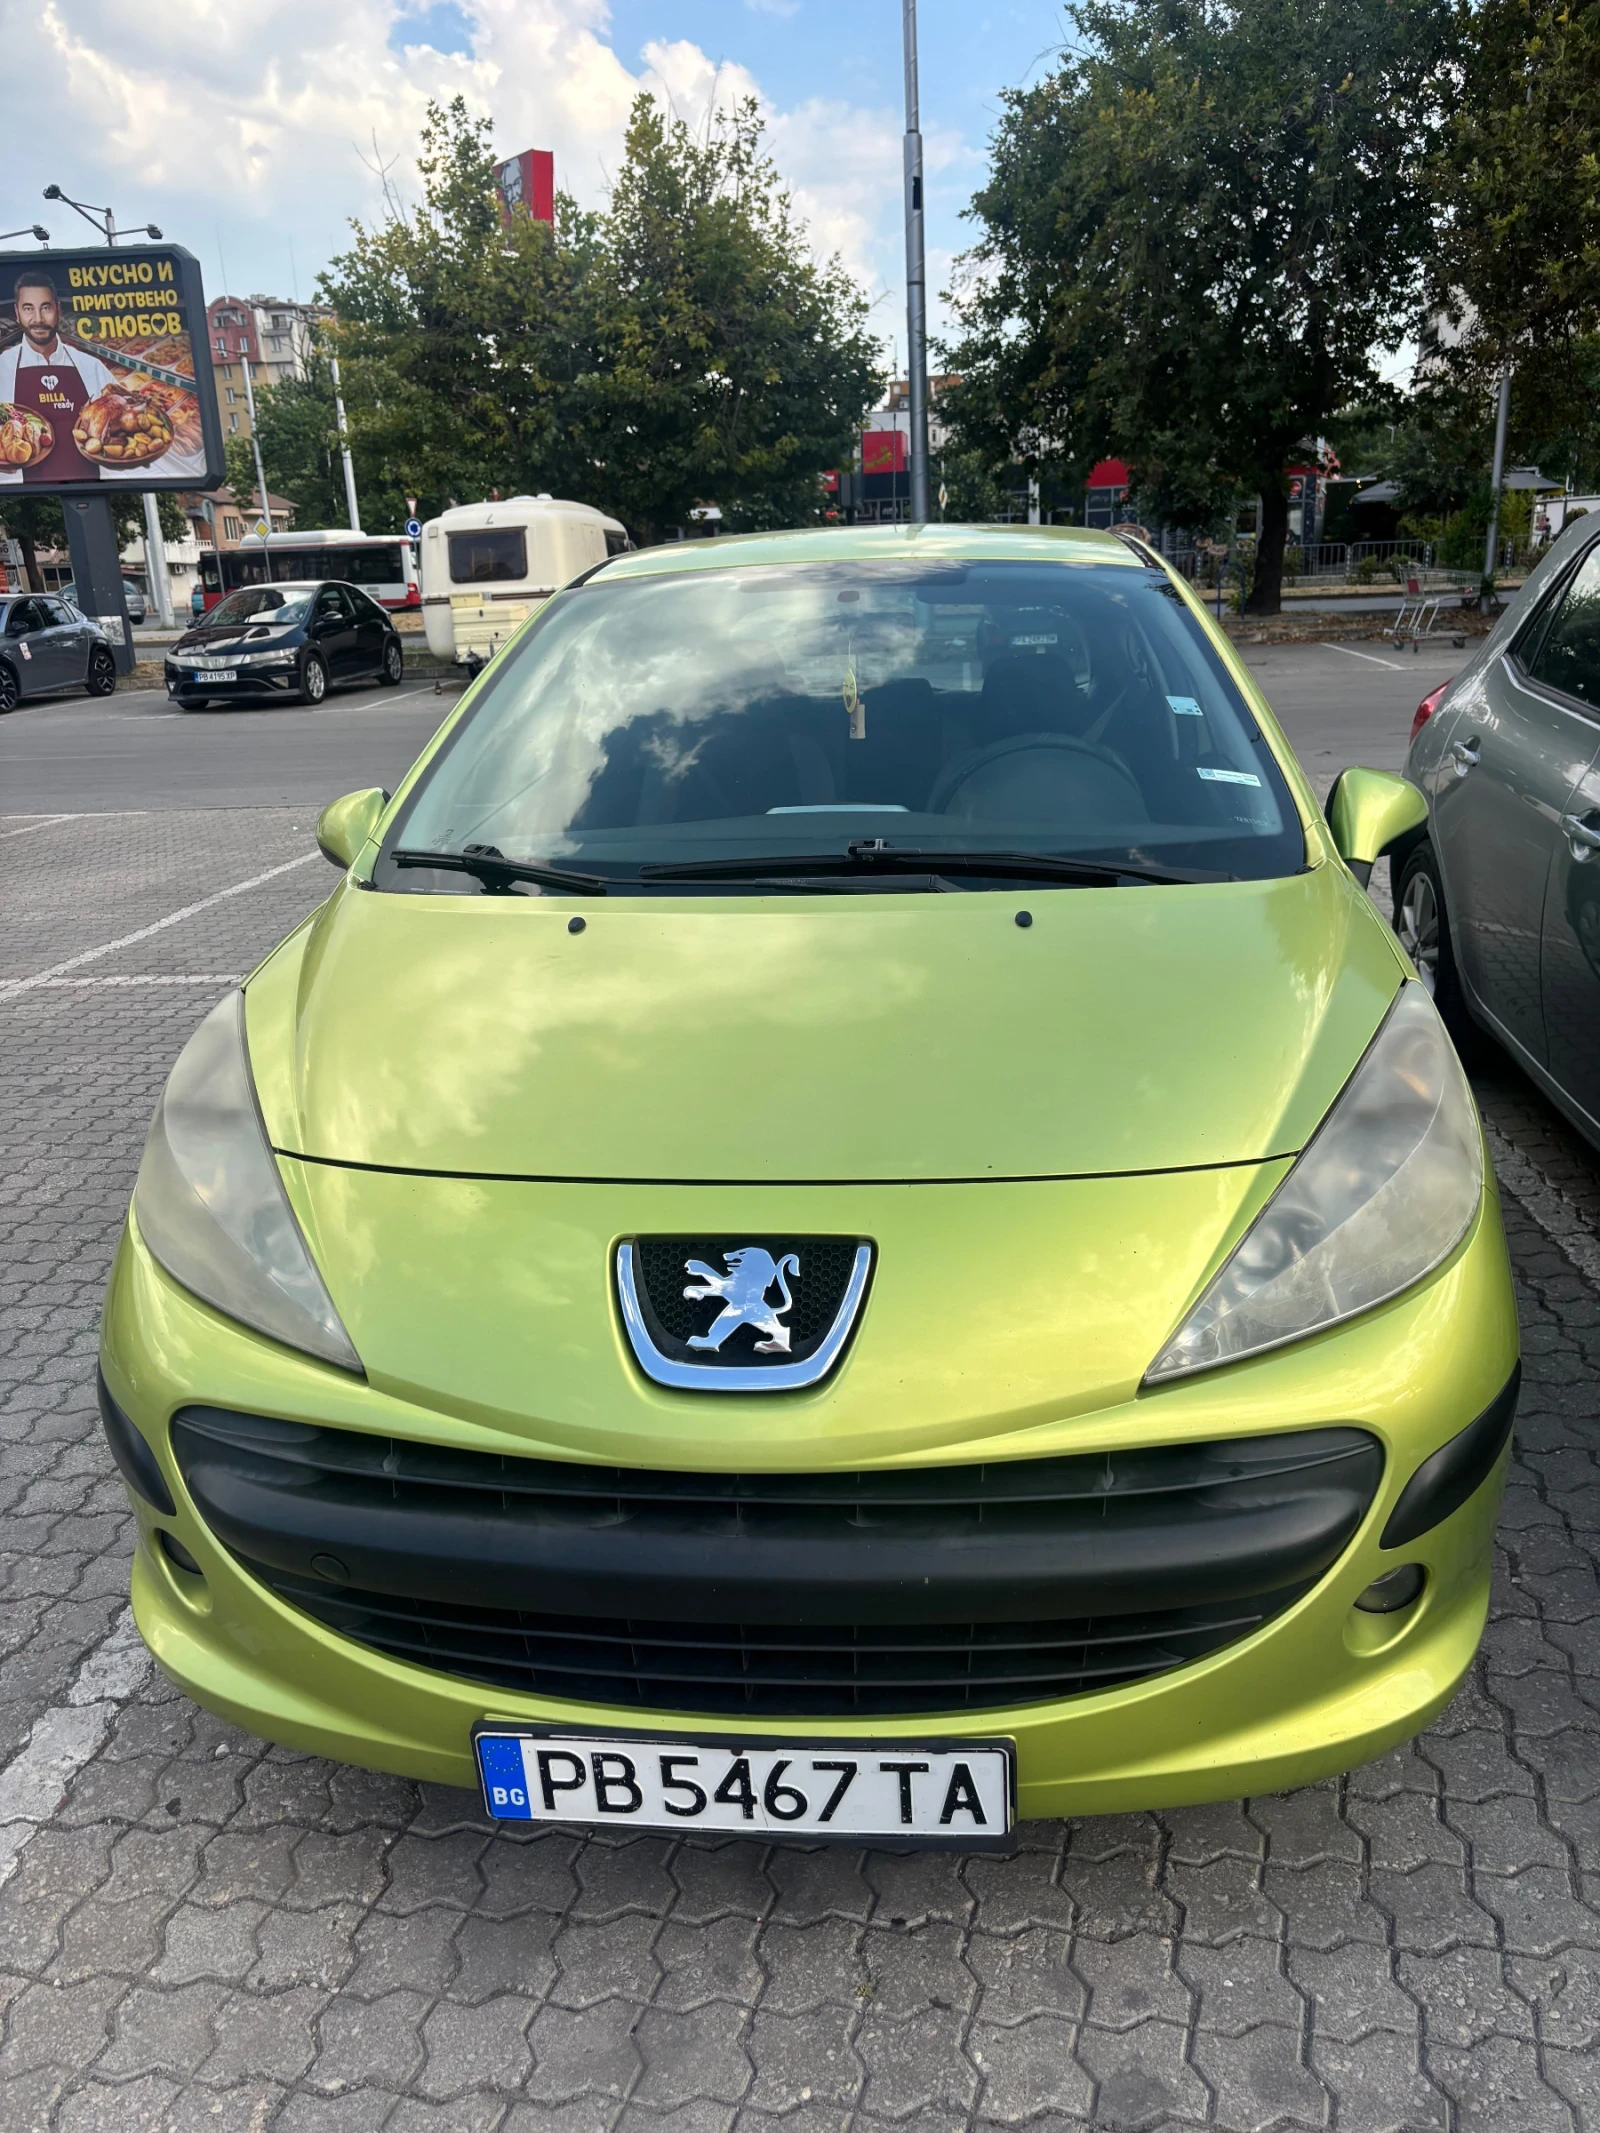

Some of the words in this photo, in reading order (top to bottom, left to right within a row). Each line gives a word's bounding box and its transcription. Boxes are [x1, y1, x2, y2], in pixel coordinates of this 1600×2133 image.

[69, 263, 153, 287] ВКУСНО
[157, 261, 174, 282] И
[72, 289, 178, 312] ПРИГОТВЕНО
[77, 317, 93, 340] С
[99, 312, 182, 339] ЛЮБОВ
[39, 392, 66, 403] BILLA
[53, 399, 75, 412] ready
[493, 1787, 525, 1806] BG
[537, 1749, 644, 1814] PB
[659, 1754, 858, 1821] 5467
[879, 1761, 988, 1825] TA
